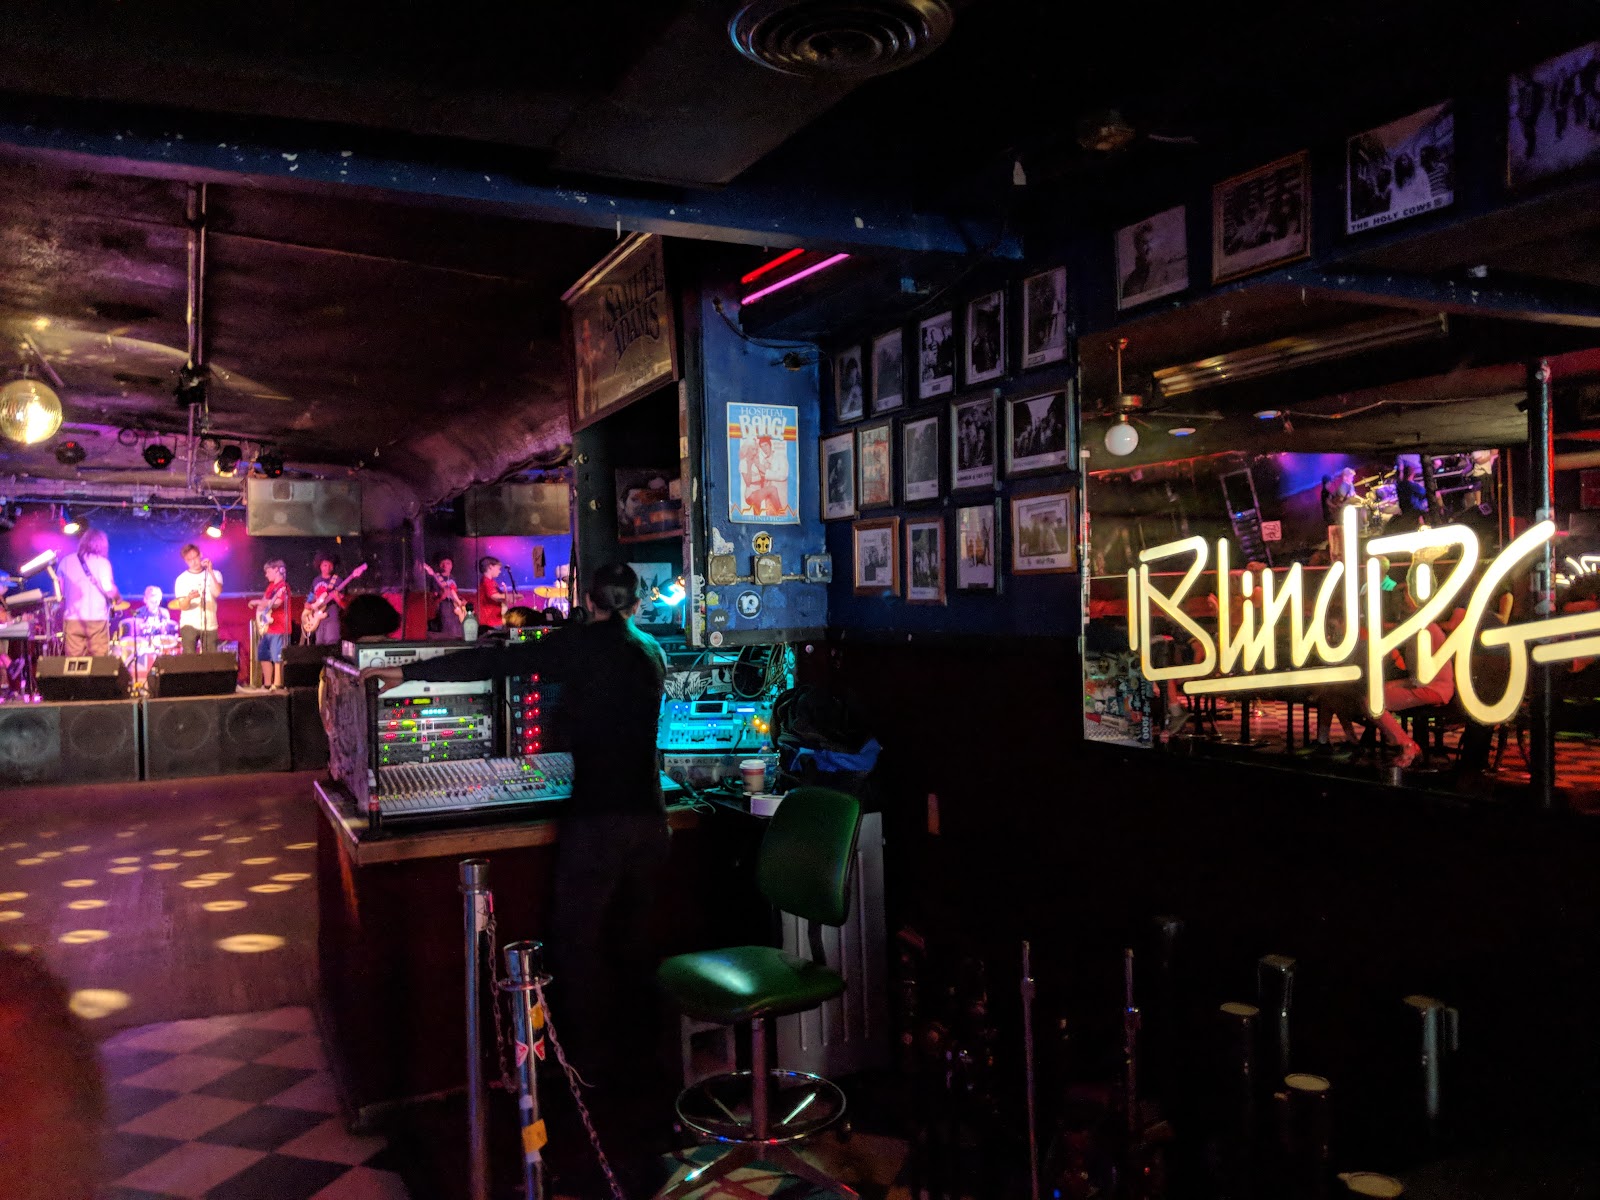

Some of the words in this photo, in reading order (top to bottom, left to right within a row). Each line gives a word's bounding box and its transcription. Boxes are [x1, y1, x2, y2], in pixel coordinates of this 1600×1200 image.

[1350, 220, 1369, 231] THE
[1373, 211, 1399, 225] HOLY
[1403, 202, 1432, 216] COWS
[742, 406, 785, 418] HOSPITAL
